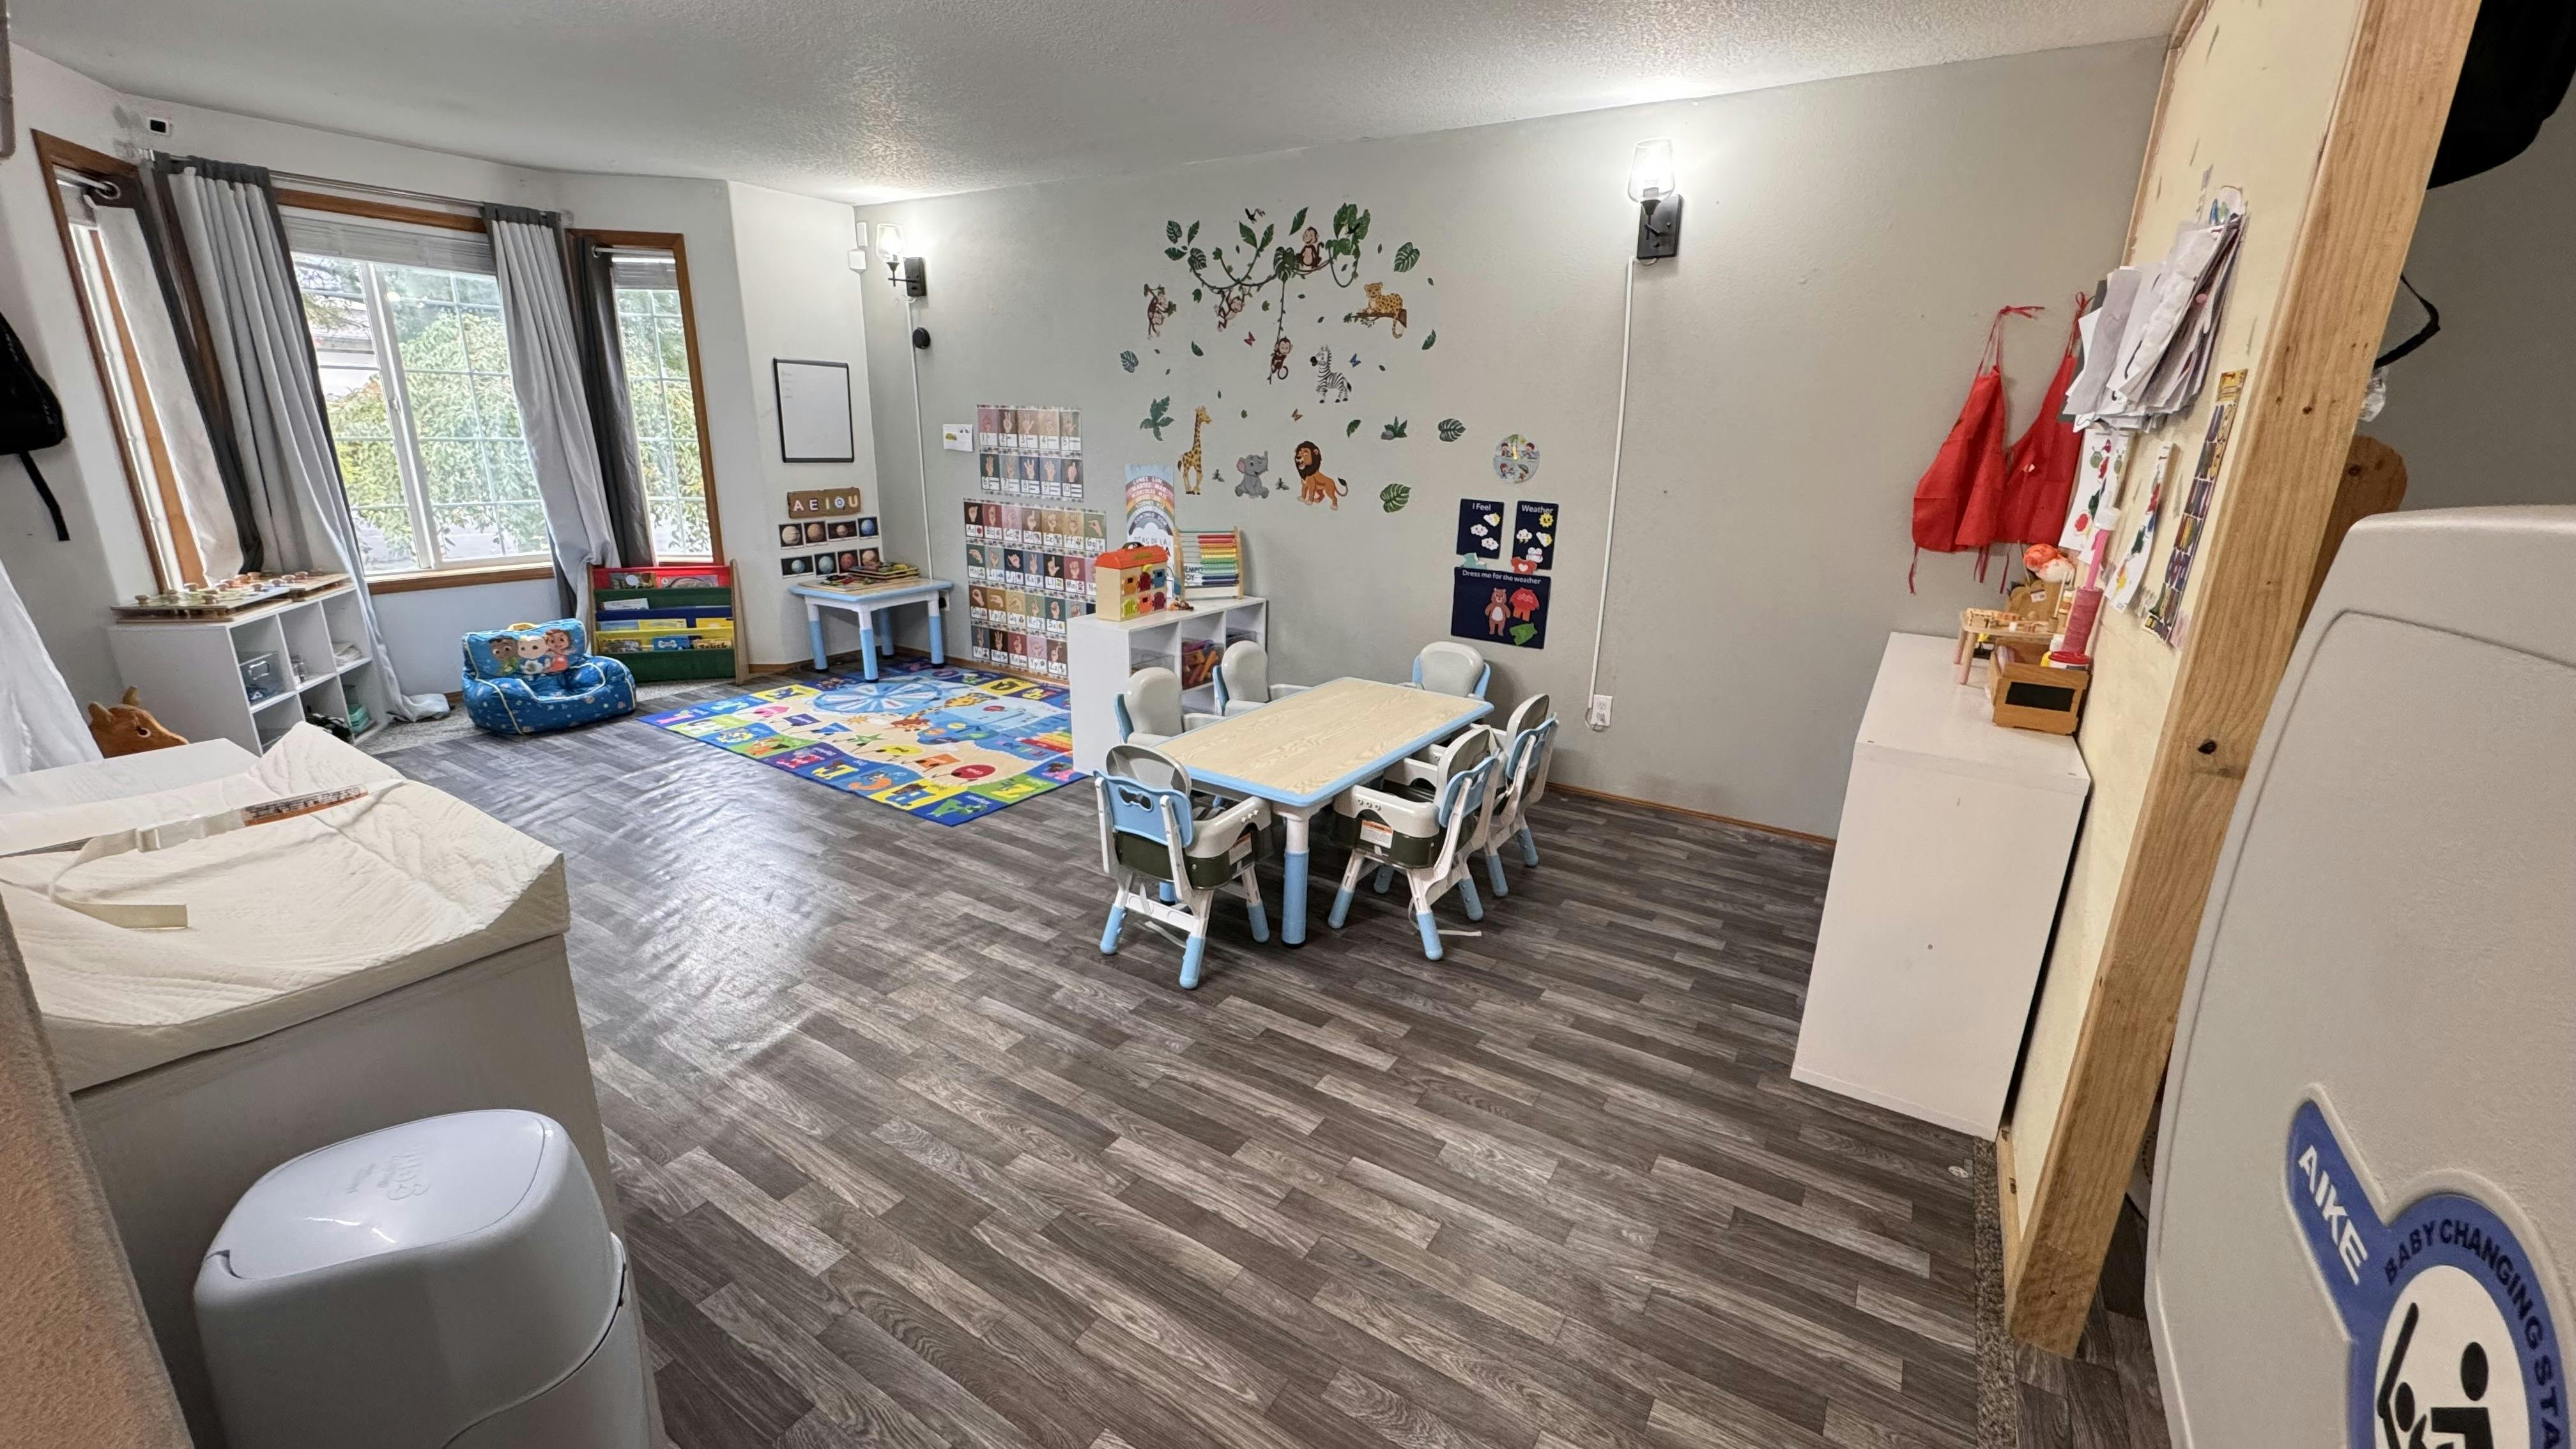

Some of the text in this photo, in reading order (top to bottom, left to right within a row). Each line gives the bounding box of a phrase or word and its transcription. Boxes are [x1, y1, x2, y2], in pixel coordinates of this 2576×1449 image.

[1064, 484, 1070, 493] 10
[793, 495, 858, 512] A E I O U
[1476, 503, 1491, 512] Feel
[1522, 505, 1554, 514] Weather
[1087, 539, 1096, 549] Gg
[1462, 570, 1480, 578] Dress
[1492, 572, 1502, 580] for
[1514, 576, 1542, 585] weather
[2297, 1144, 2368, 1286] AIKE
[2384, 1220, 2435, 1287] BABY
[2439, 1218, 2544, 1351] CHANGING
